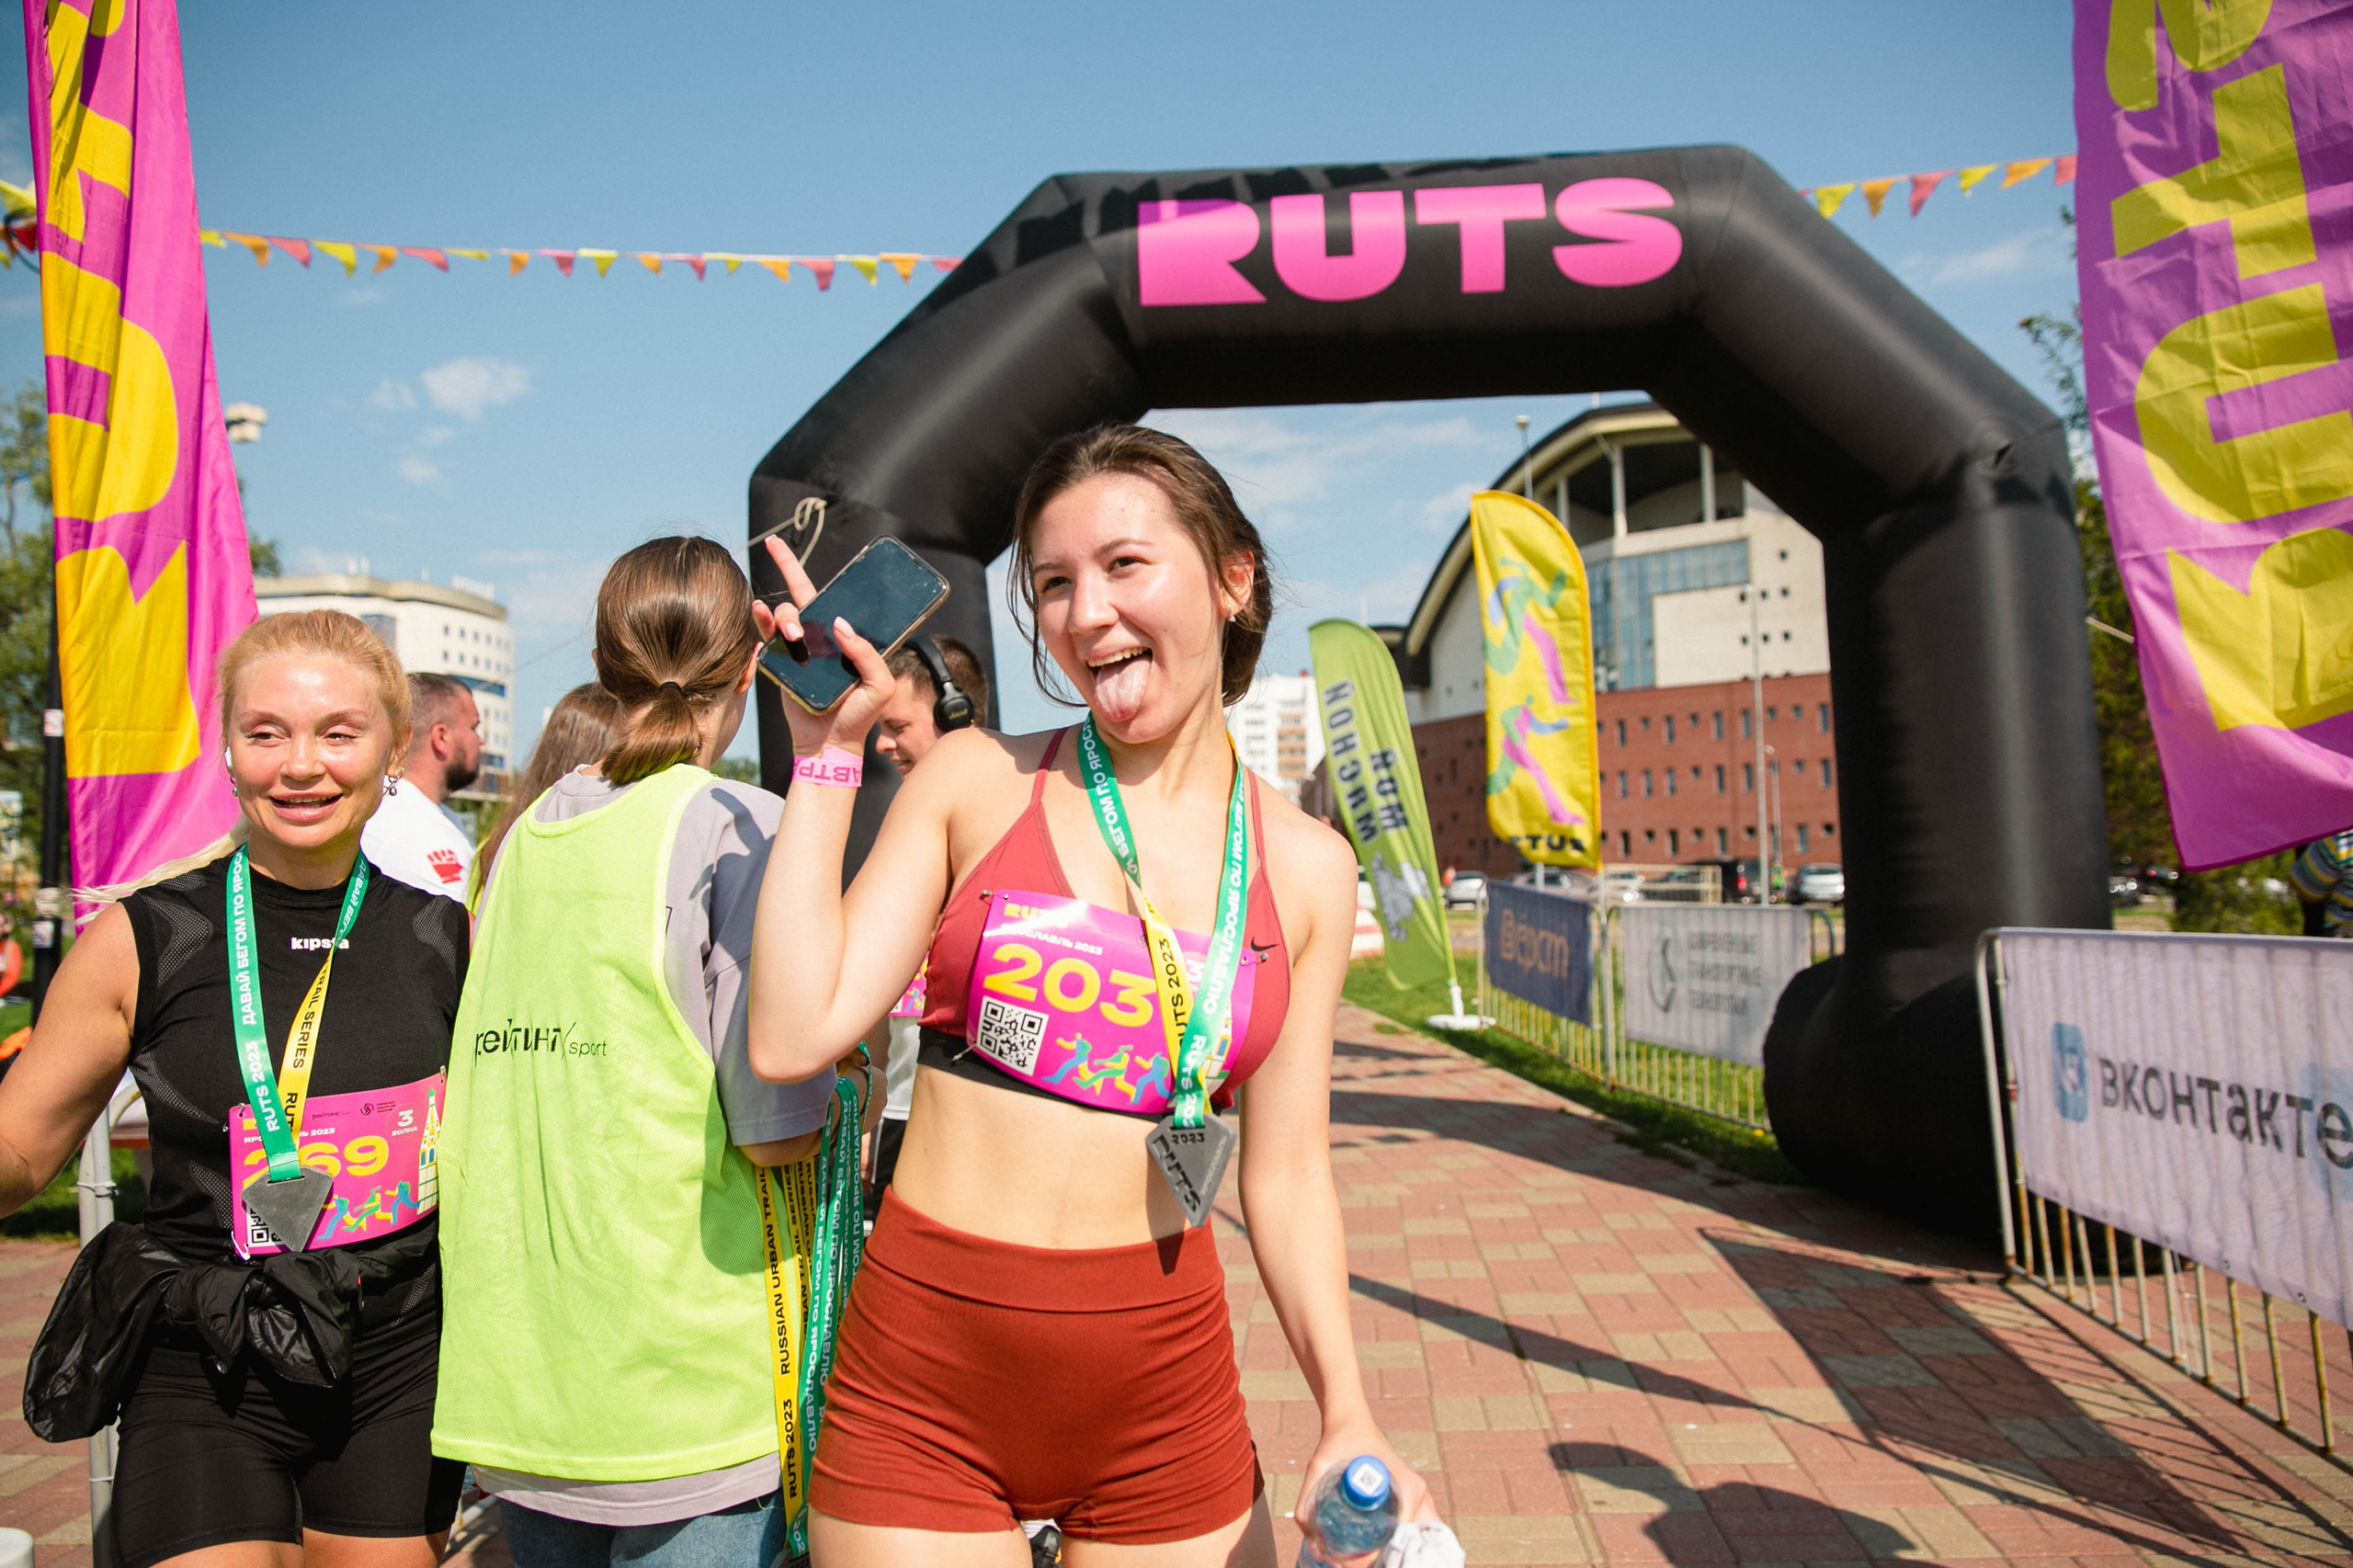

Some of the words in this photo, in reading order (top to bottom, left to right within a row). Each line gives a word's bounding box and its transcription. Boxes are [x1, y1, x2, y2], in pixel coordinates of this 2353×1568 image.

[1137, 176, 1683, 307] RUTS
[42, 0, 200, 778] RUT
[1093, 771, 1110, 797] ПО
[1099, 796, 1130, 858] БЕГОМ
[1232, 801, 1244, 860] БЕГОМ
[349, 858, 368, 907] ДАВАЙ
[1230, 860, 1243, 888] ПО
[233, 895, 245, 916] ПО
[233, 916, 250, 969] БЕГОМ
[1074, 941, 1104, 956] 2023
[1159, 937, 1181, 989] 2023
[1203, 887, 1240, 1014] ЯРОСЛАВЛЮ
[235, 971, 257, 1026] ДАВАЙ
[983, 943, 1157, 1028] 203
[292, 1011, 315, 1069] SERIES
[1172, 993, 1188, 1046] UTS
[245, 1040, 266, 1083] 2023
[1181, 1034, 1207, 1090] RUTS
[256, 1084, 280, 1132] RUTS
[284, 1092, 298, 1134] RUT
[310, 1128, 335, 1136] 2023
[397, 1109, 414, 1128] 3
[839, 1100, 848, 1164] ДАВАЙ
[852, 1096, 860, 1208] ЯРОСЛАВЛЮ
[1172, 1132, 1206, 1145] 2023
[759, 1166, 771, 1221] TRAIL
[797, 1161, 810, 1236] RUSSIAN
[819, 1156, 827, 1222] ДАВАЙ
[832, 1167, 844, 1231] БЕГОМ
[1152, 1134, 1201, 1212] RUTS
[830, 1234, 839, 1261] ПО
[853, 1210, 860, 1235] ПО
[766, 1223, 780, 1290] URBAN
[794, 1229, 805, 1279] TRAIL
[815, 1226, 824, 1290] БЕГОМ
[774, 1292, 790, 1376] RUSSIAN
[812, 1294, 820, 1323] ПО
[820, 1264, 836, 1386] ЯРОСЛАВЛЮ
[805, 1325, 818, 1452] ЯРОСЛАВЛЮ
[783, 1399, 795, 1444] 2023
[787, 1447, 798, 1499] RUTS
